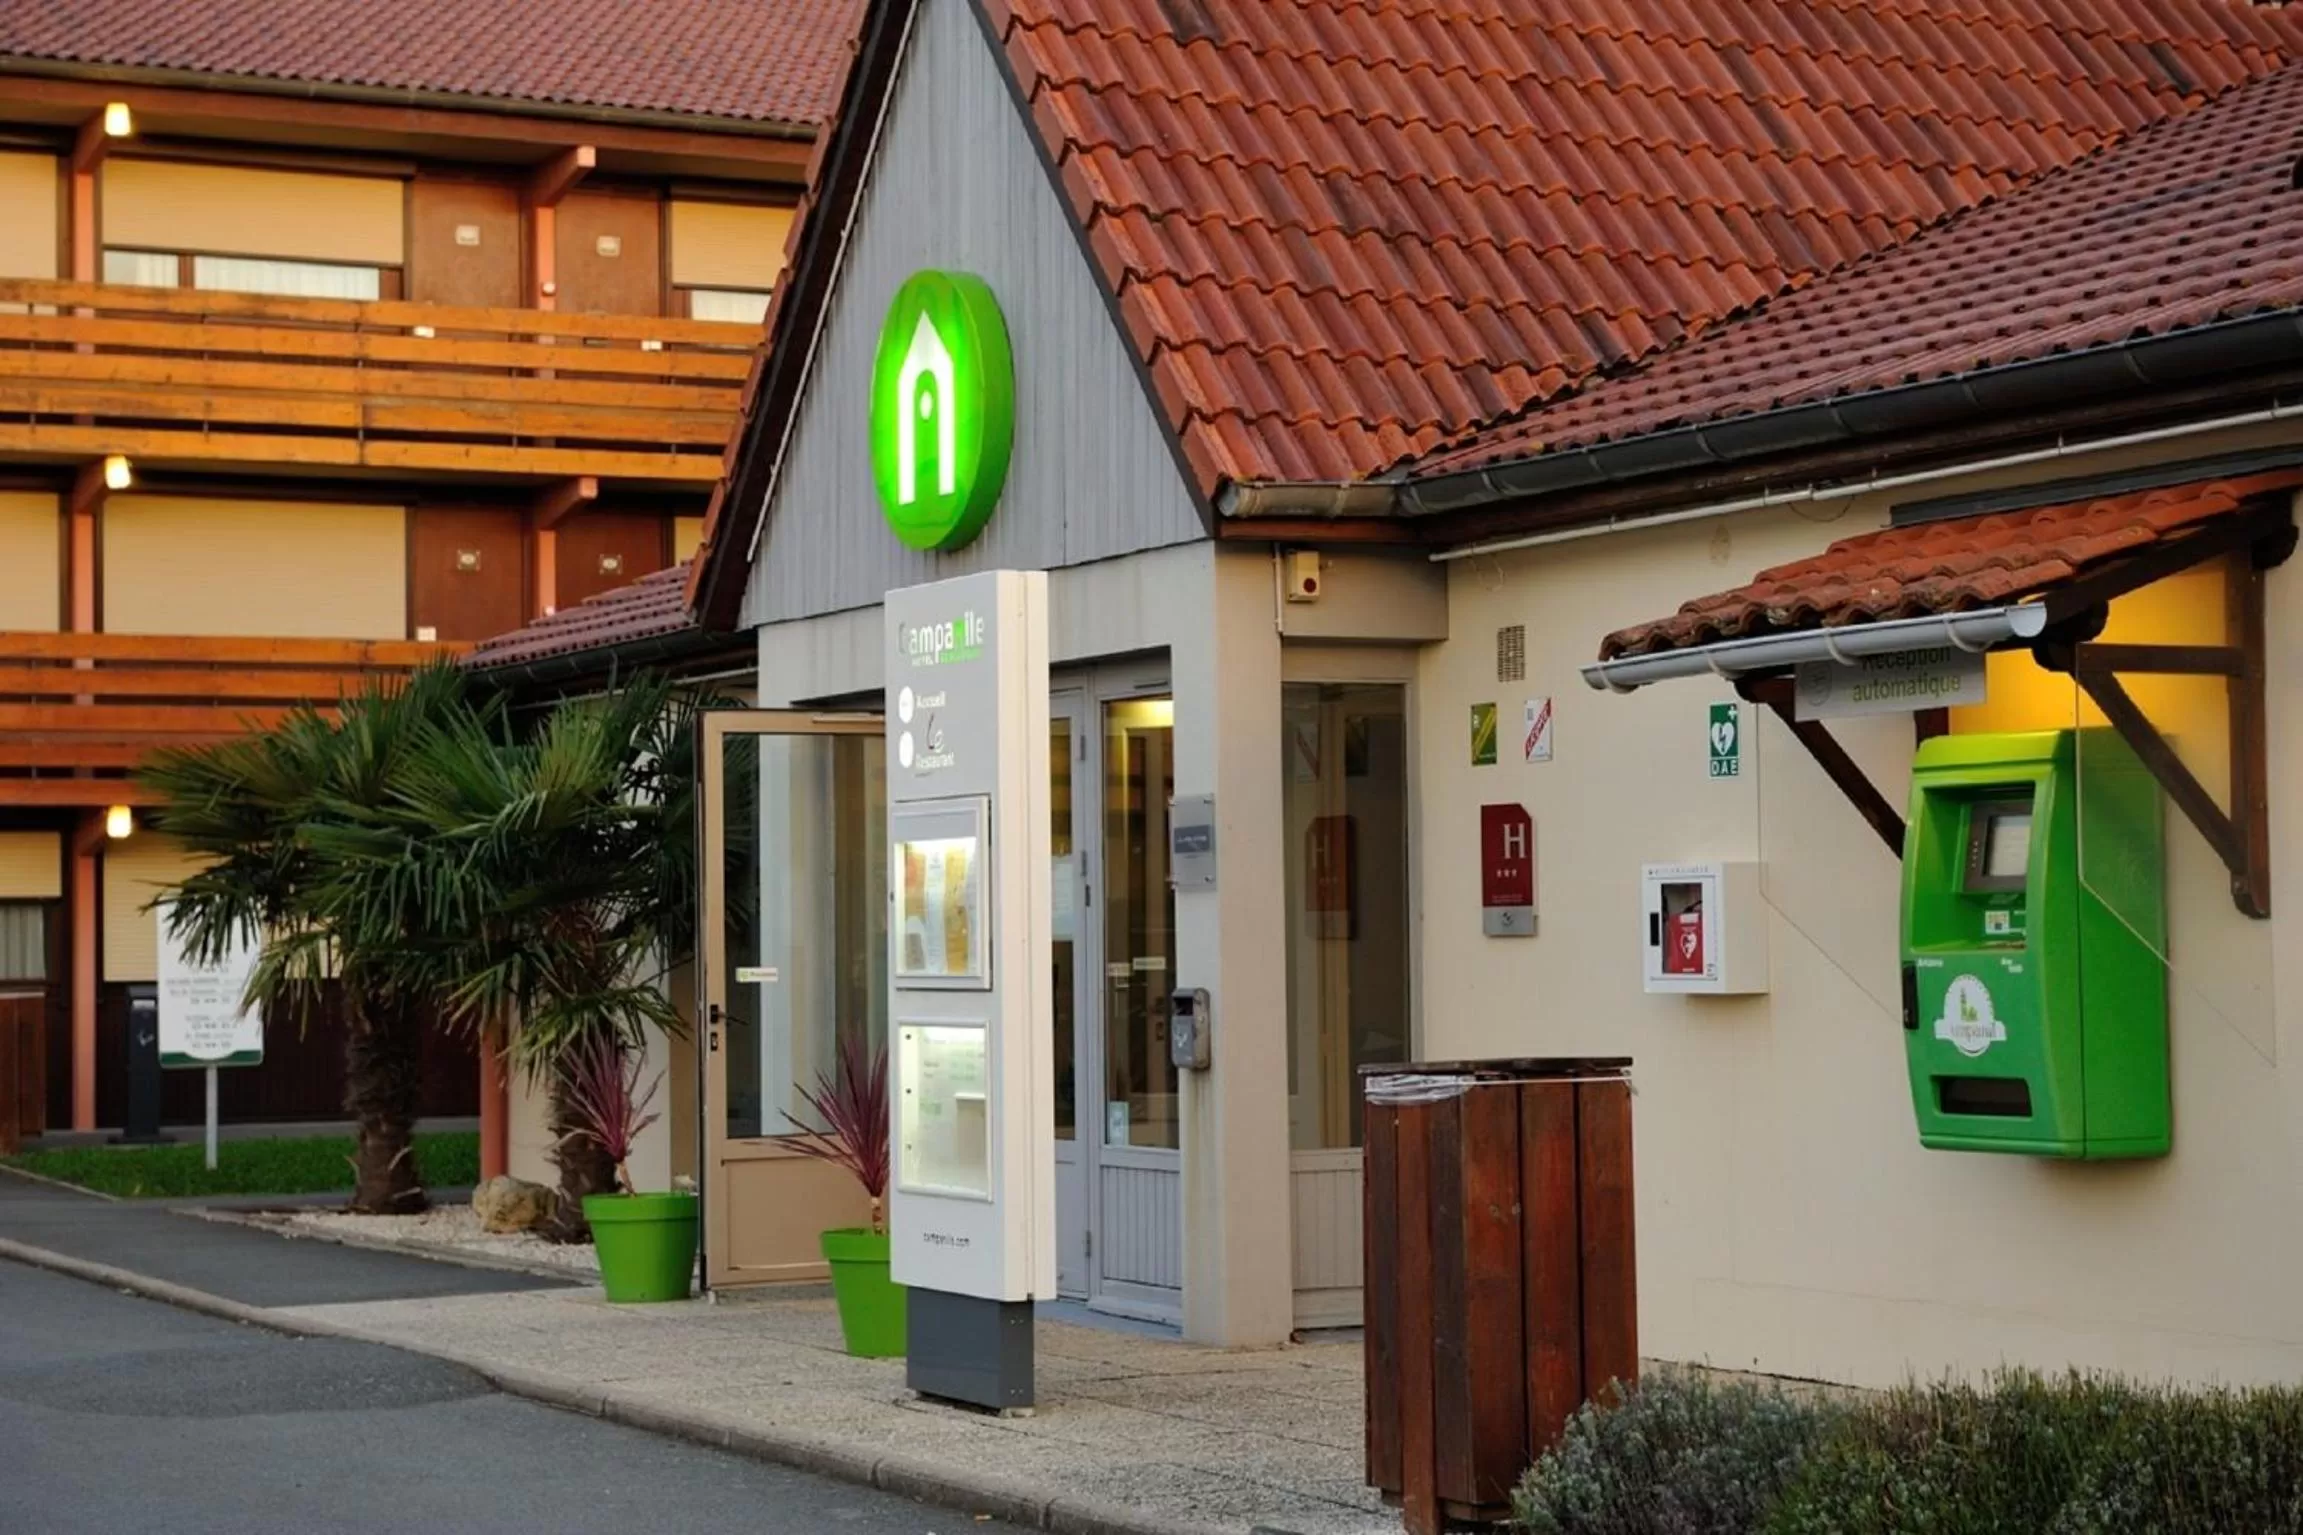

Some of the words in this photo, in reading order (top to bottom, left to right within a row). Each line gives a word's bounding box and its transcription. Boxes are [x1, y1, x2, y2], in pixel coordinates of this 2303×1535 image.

[898, 610, 984, 665] Campaile
[1852, 673, 1961, 702] automatique
[1711, 759, 1737, 775] DAE
[1503, 822, 1525, 859] H
